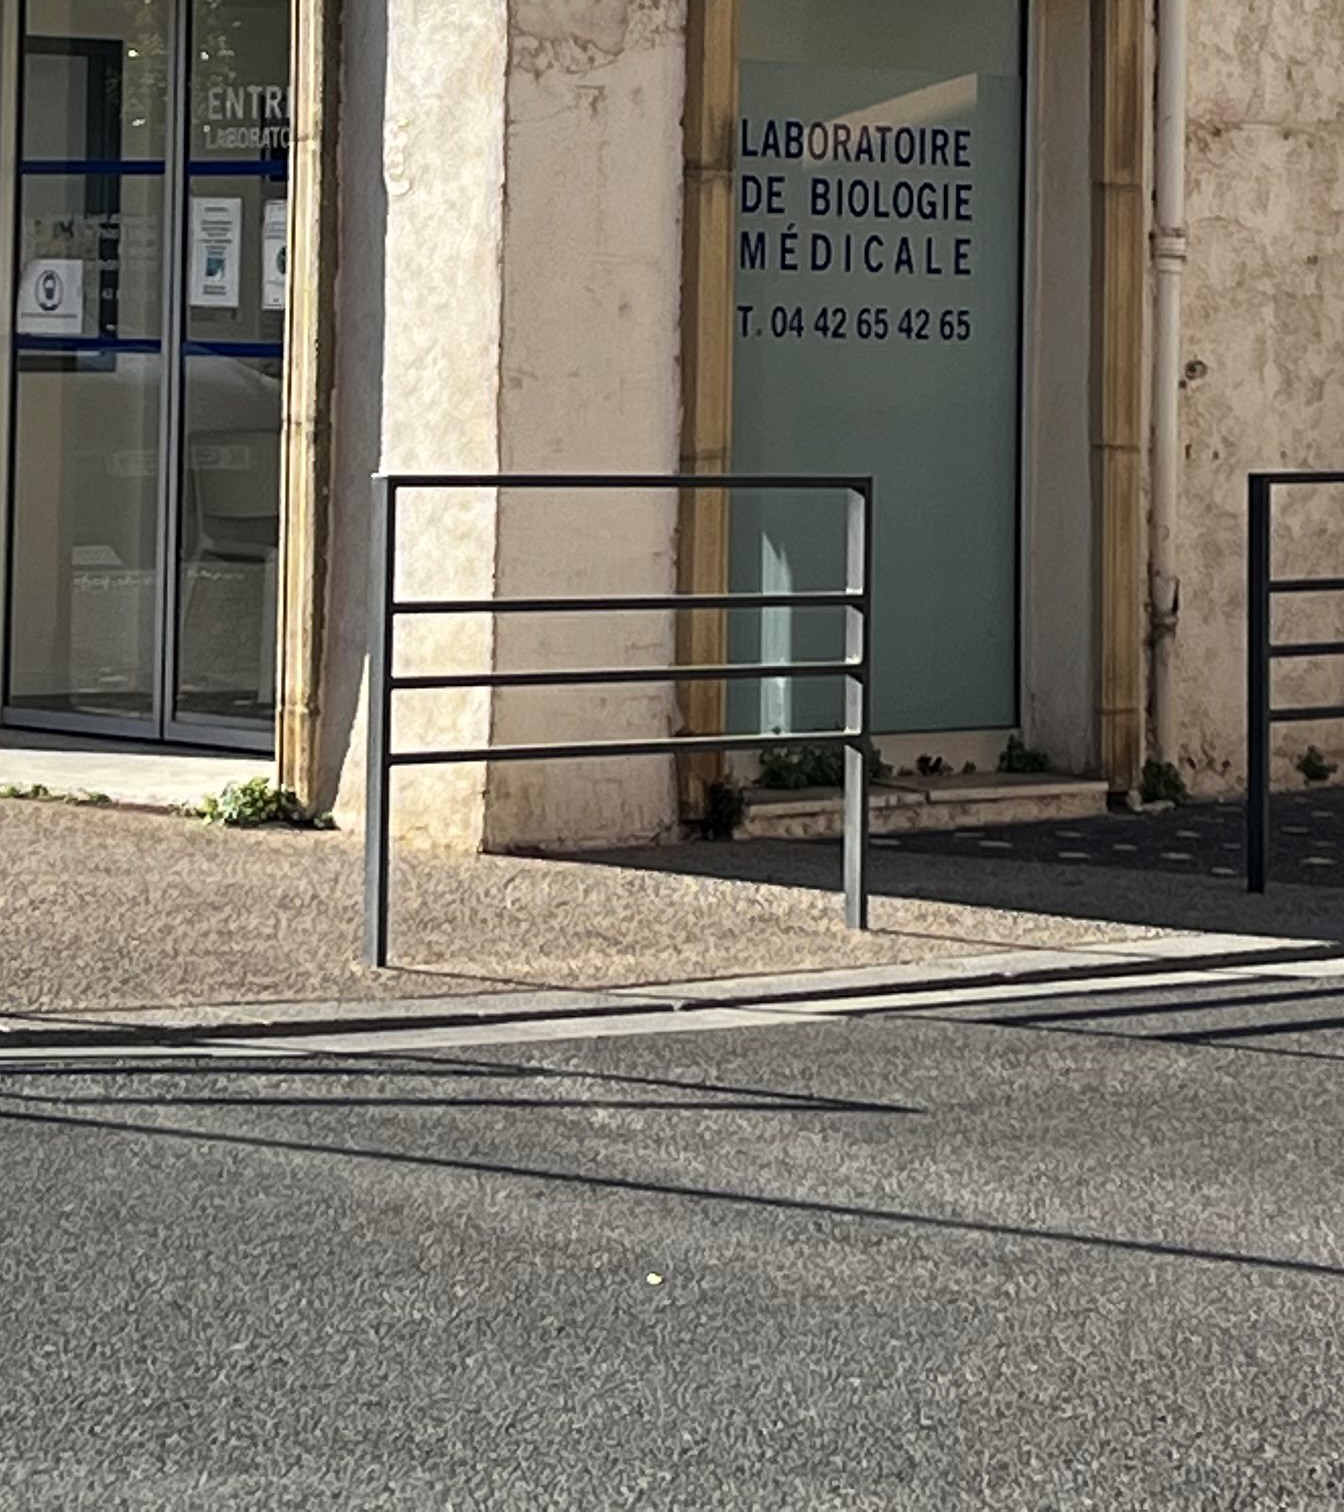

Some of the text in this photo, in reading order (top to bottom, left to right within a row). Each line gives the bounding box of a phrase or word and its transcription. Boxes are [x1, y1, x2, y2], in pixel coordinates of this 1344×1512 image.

[741, 118, 972, 168] LABORATOIRE
[741, 175, 973, 222] DE BIOLOGIE
[739, 223, 972, 276] MÉDICALE
[771, 306, 804, 339] 04
[814, 307, 848, 339] 42
[857, 308, 889, 340] 65
[899, 308, 931, 340] 42
[940, 310, 971, 341] 65
